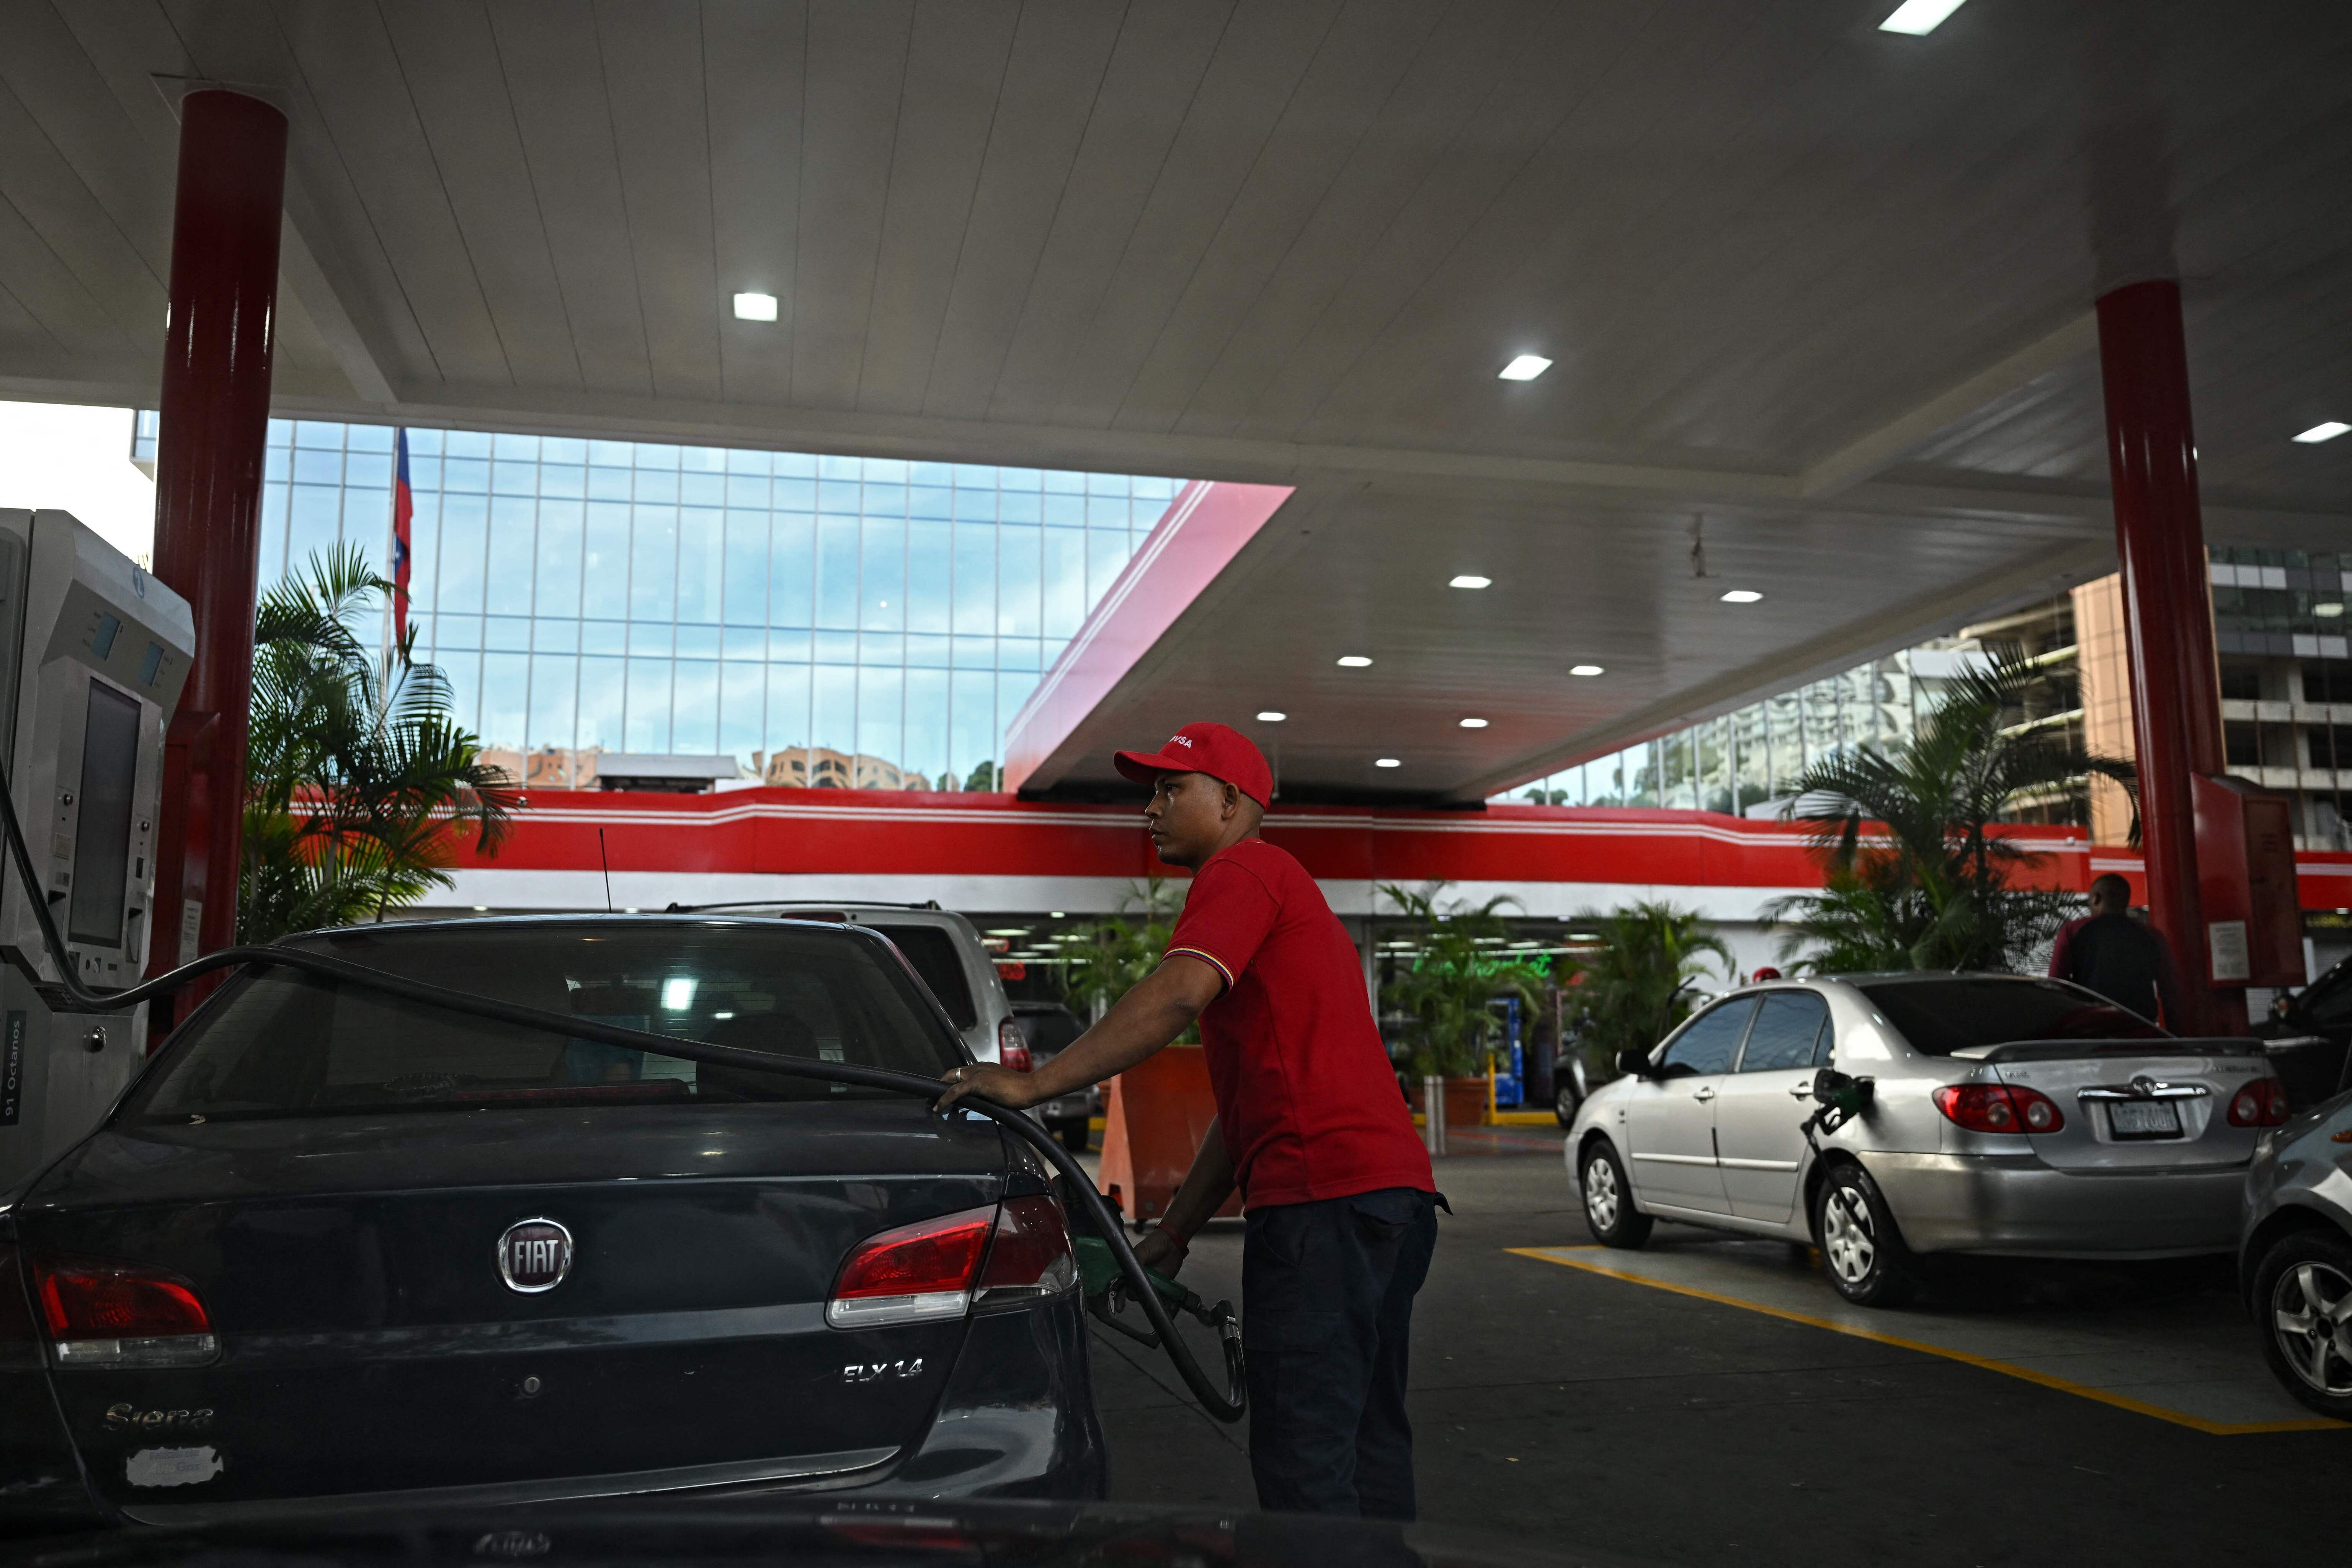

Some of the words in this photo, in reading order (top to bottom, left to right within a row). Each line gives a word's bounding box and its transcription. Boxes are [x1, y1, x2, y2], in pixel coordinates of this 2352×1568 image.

[8, 1020, 20, 1090] Octanos
[5, 1098, 14, 1117] 91
[514, 1239, 559, 1274] FIAT
[843, 1363, 888, 1383] ELX
[102, 1403, 214, 1431] Siena
